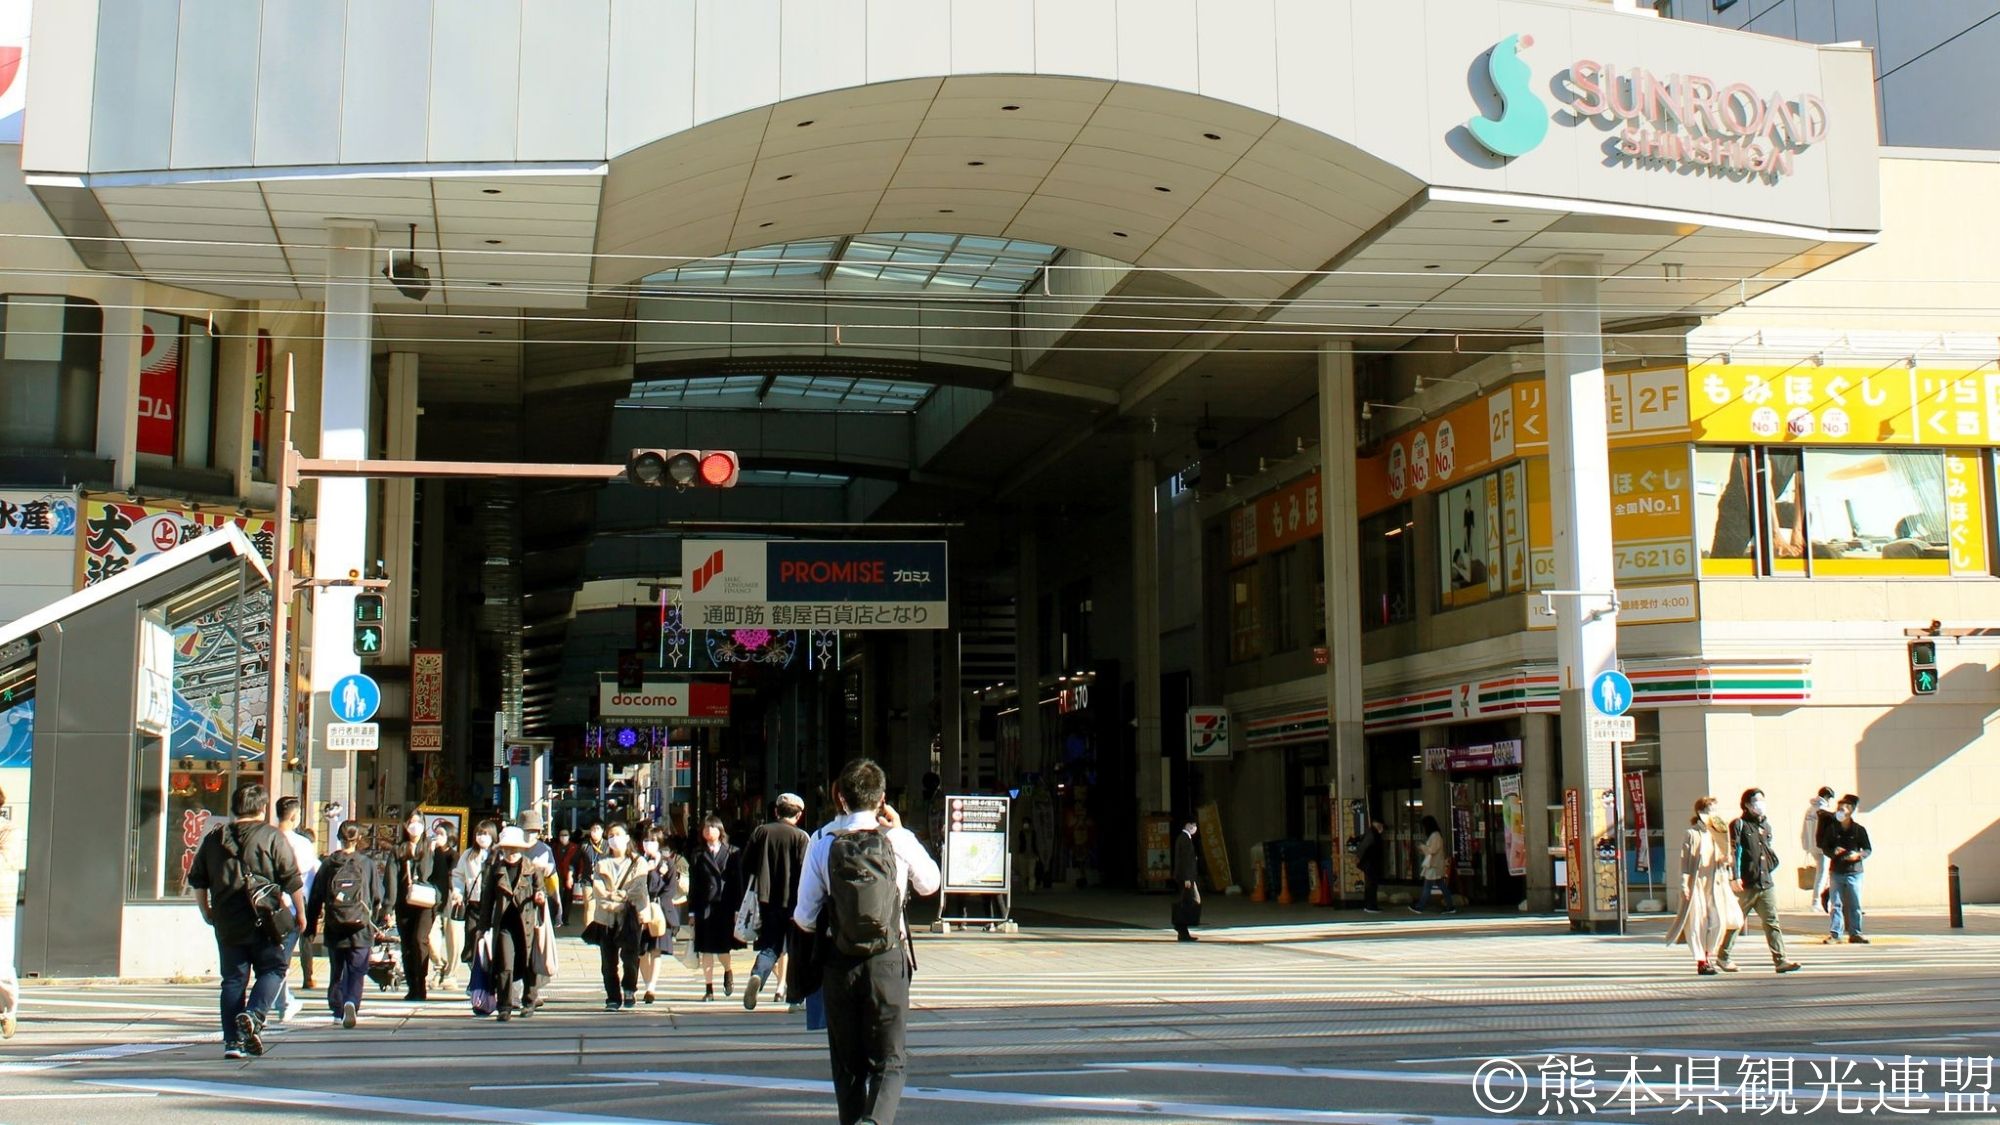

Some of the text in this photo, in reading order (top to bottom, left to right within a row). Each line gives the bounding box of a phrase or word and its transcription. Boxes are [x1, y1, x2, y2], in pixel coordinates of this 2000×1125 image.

[1569, 59, 1830, 146] SUNROAD
[1639, 385, 1679, 413] 2F
[1702, 373, 1887, 407] もみほぐし
[1492, 408, 1511, 443] 2F
[1613, 469, 1681, 496] ほぐし
[1948, 455, 1970, 569] もみほぐし
[780, 561, 885, 584] PROMISE
[892, 570, 930, 583] プロミス
[703, 605, 928, 626] 通町筋 鶴屋百貨店となり
[612, 688, 678, 706] docomo
